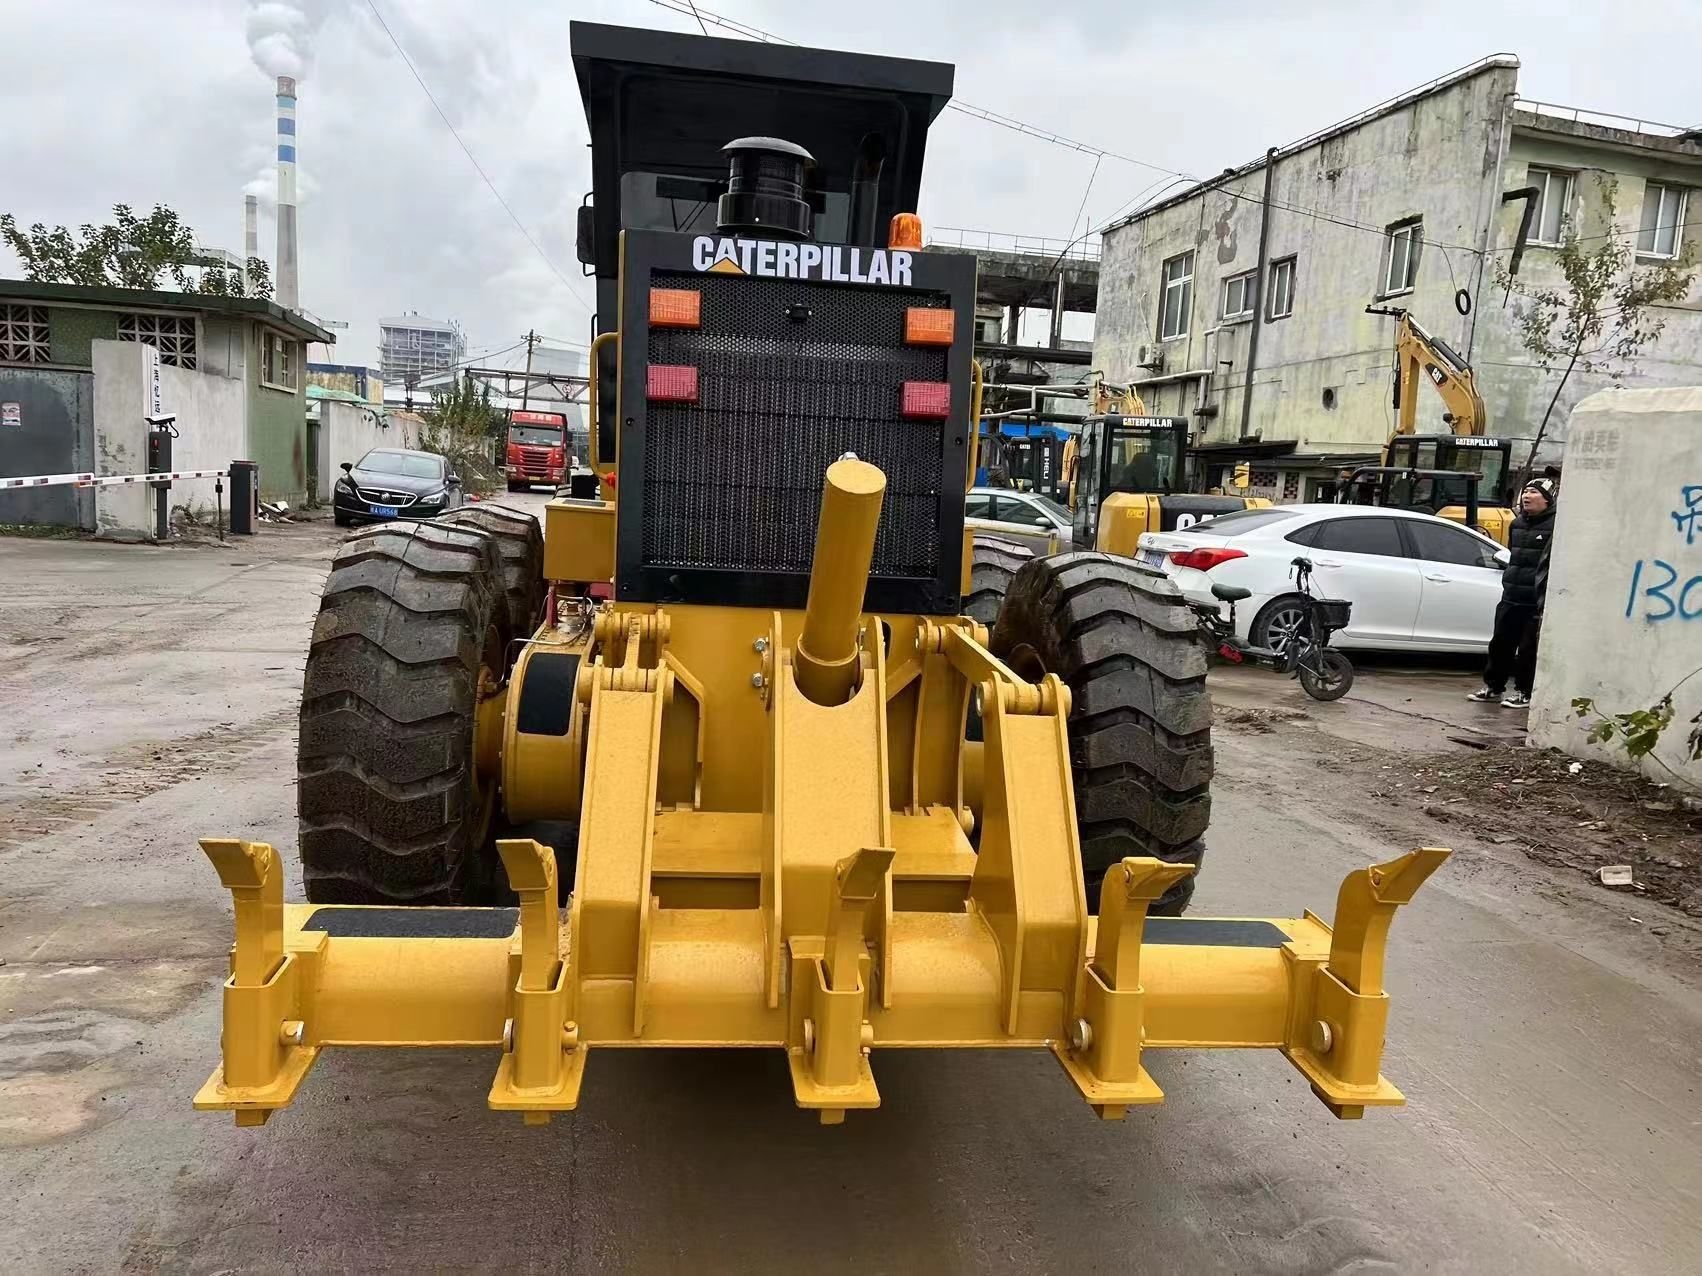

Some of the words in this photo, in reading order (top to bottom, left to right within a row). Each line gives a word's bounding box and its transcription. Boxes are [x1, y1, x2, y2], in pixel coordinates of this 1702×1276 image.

[692, 236, 913, 286] CATERPILLAR
[1431, 367, 1443, 383] CAT
[1122, 417, 1173, 428] CATERPILLAR
[1455, 438, 1499, 447] CATERPILLAR
